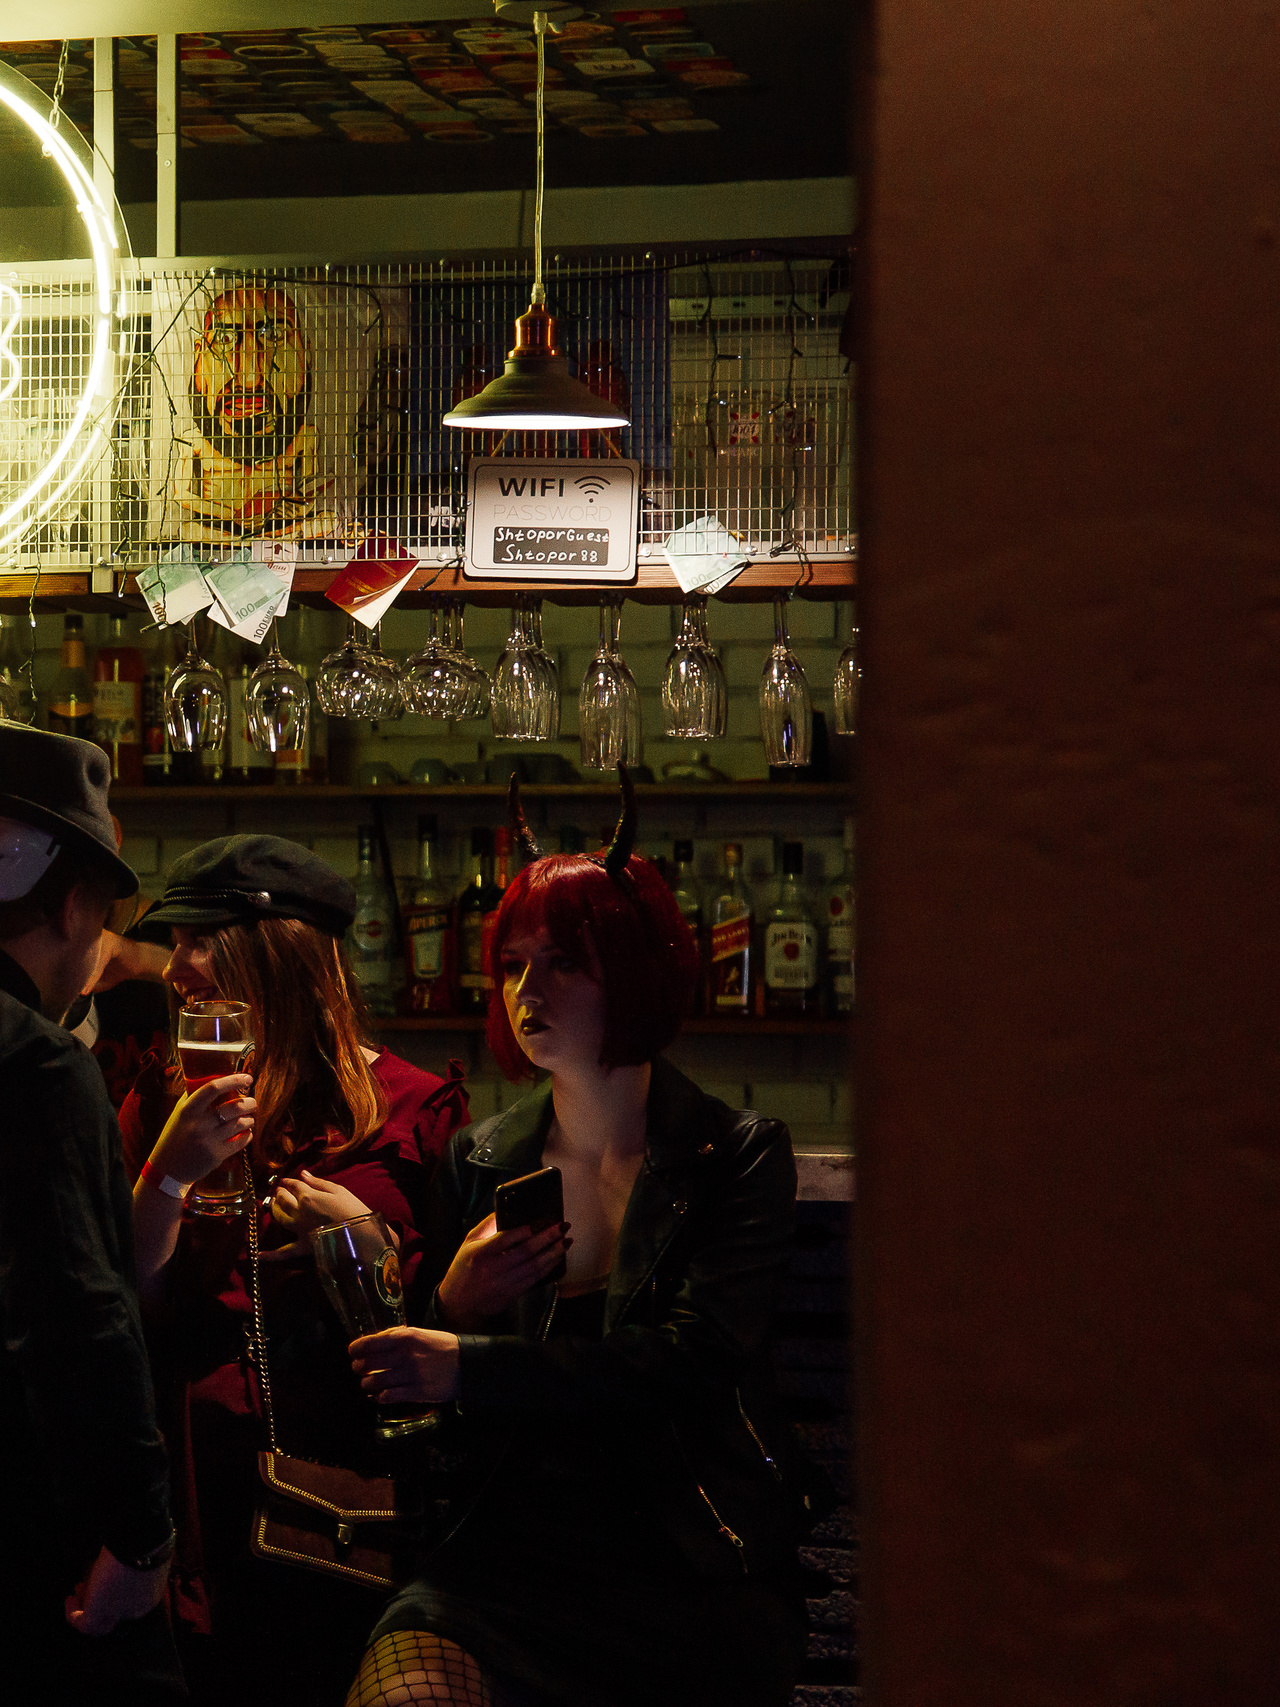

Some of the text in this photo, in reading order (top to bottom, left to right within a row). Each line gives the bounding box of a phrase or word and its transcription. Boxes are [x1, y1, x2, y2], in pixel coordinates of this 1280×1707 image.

[498, 477, 565, 497] WIFI
[493, 504, 613, 522] PASSWORD
[235, 602, 256, 620] 100
[253, 618, 267, 639] 100
